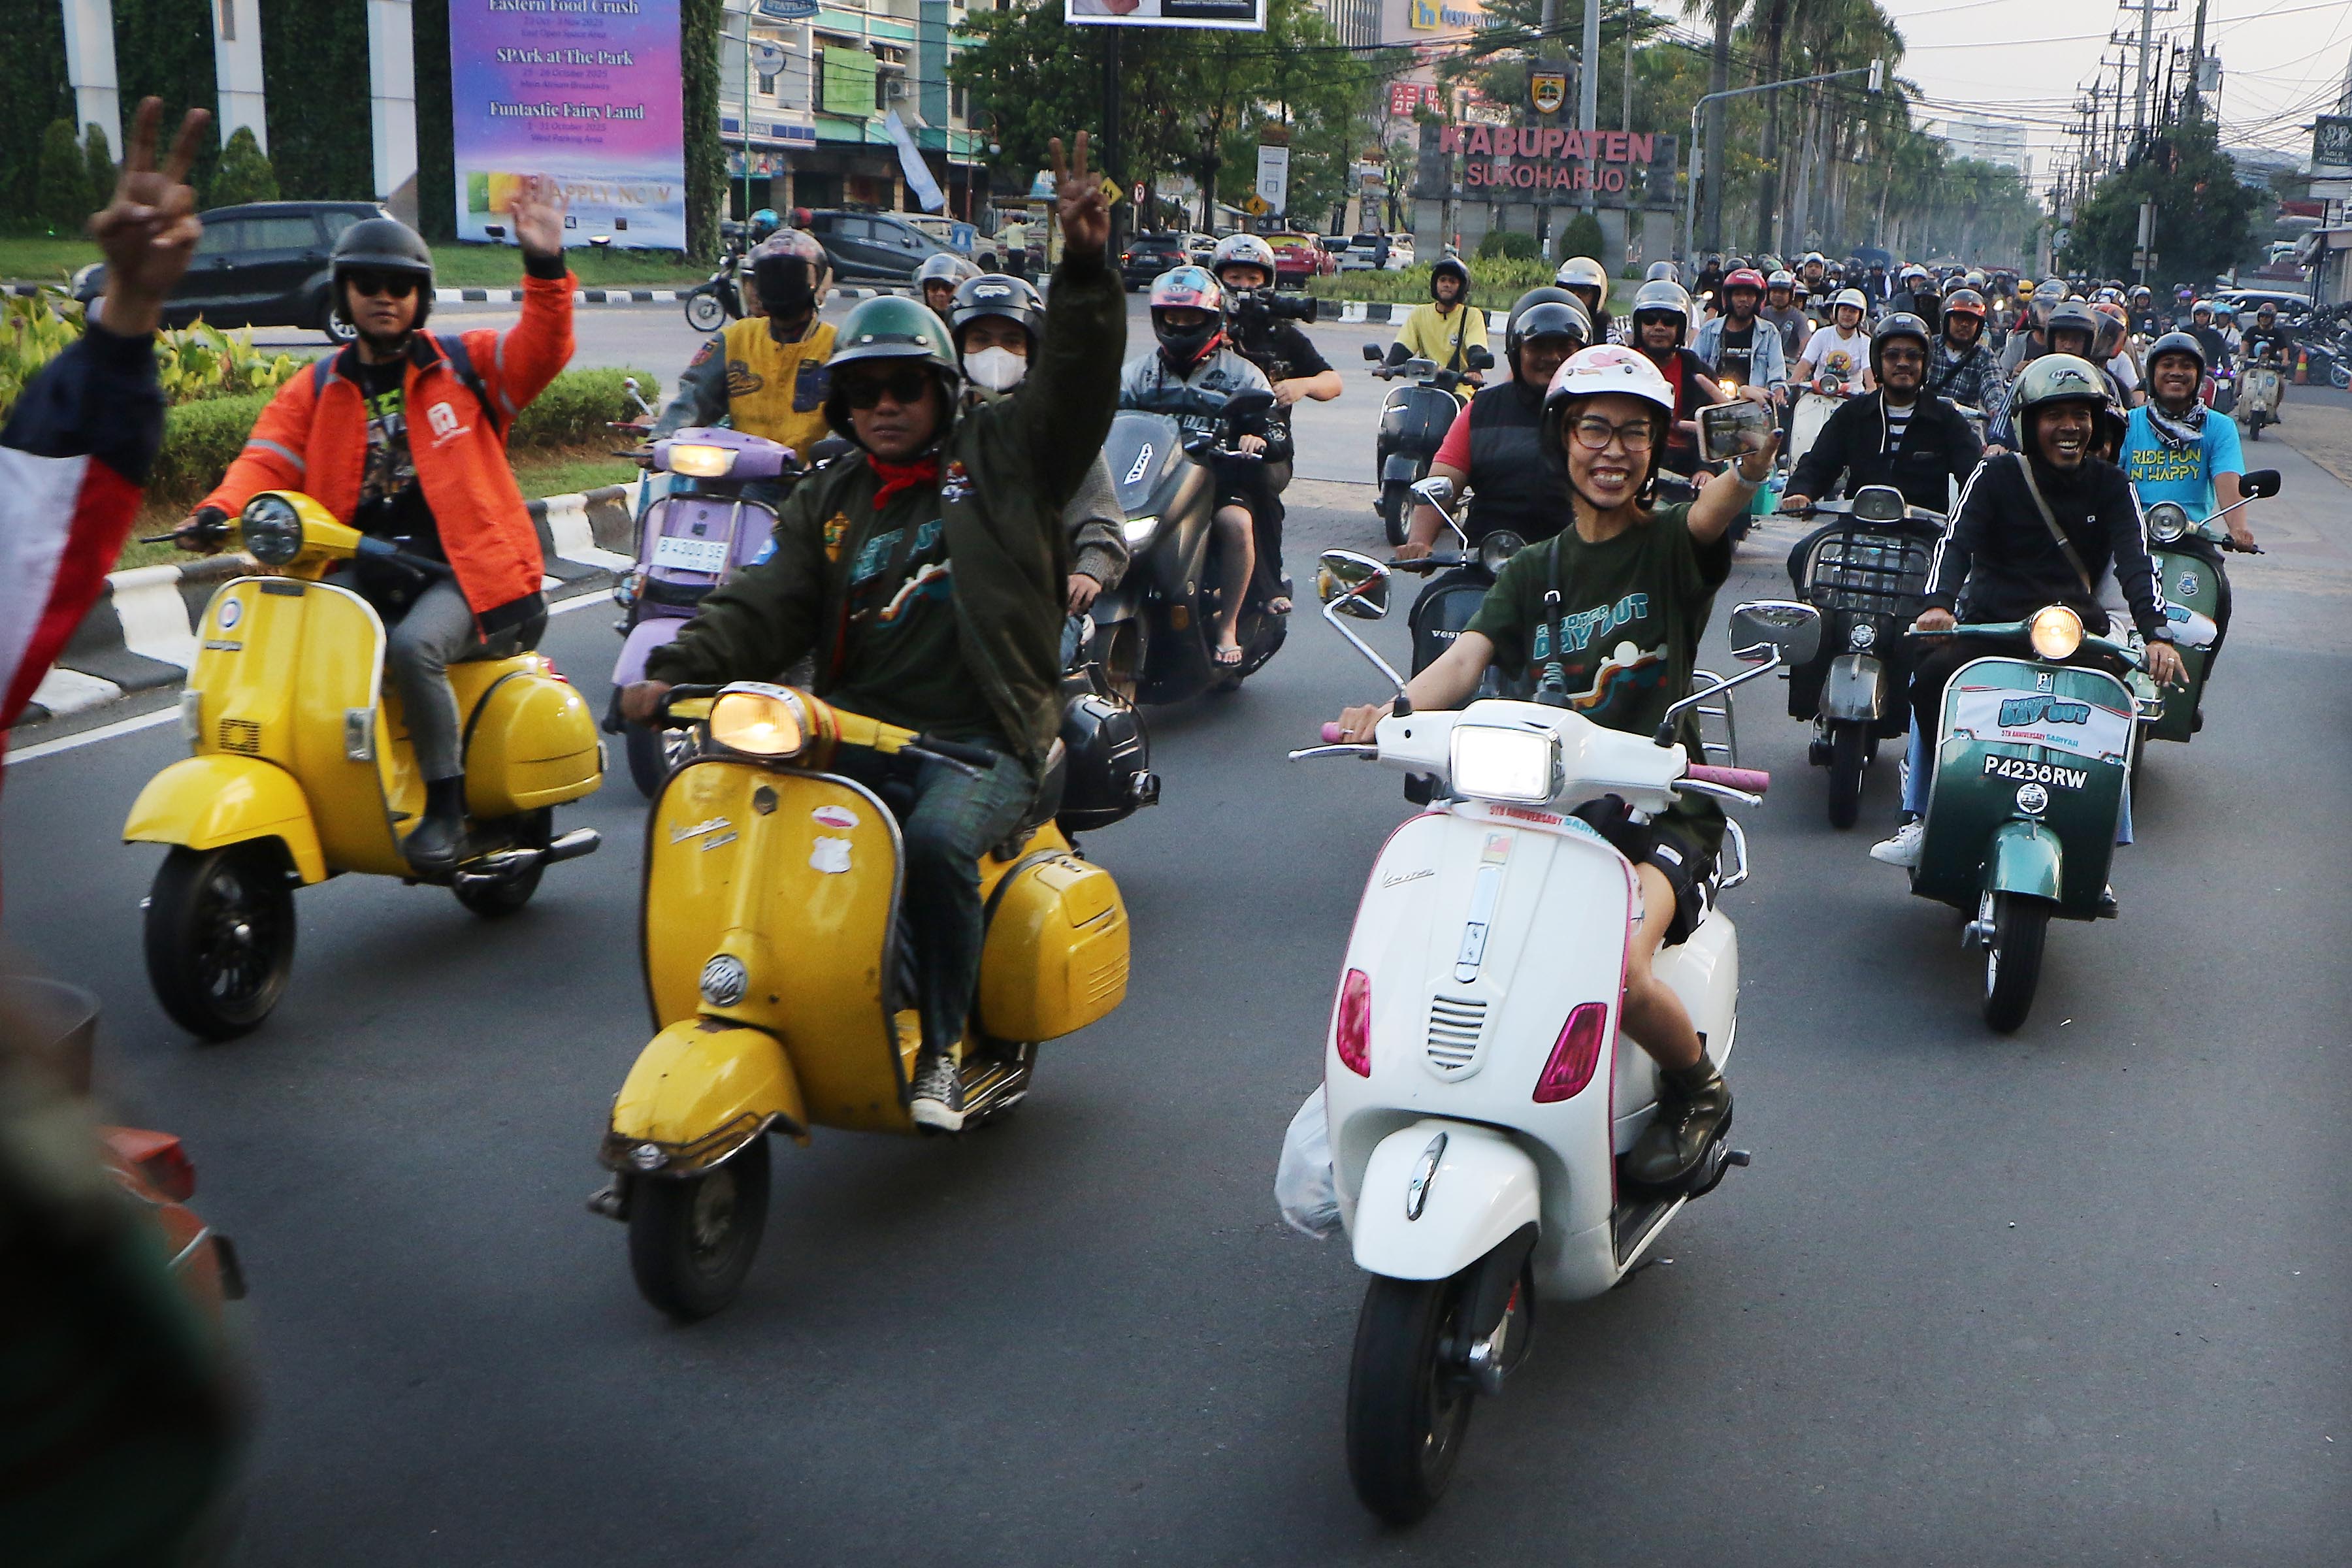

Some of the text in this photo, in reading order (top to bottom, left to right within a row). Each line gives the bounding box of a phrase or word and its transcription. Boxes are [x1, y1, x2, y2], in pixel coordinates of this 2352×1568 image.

[550, 0, 586, 12] Food
[591, 0, 640, 14] Crush
[496, 47, 633, 66] SPArk at The Park
[490, 101, 644, 120] Funtastic Fairy Land
[1439, 124, 1655, 163] KABUPATEN
[1467, 163, 1625, 192] SUKOHARJO
[2132, 448, 2202, 465] RIDE FUN
[2148, 465, 2200, 482] HAPPY
[1999, 702, 2091, 727] DAY OUT
[2012, 730, 2046, 741] ANNIVERSARY
[1984, 755, 2088, 789] P4238RW
